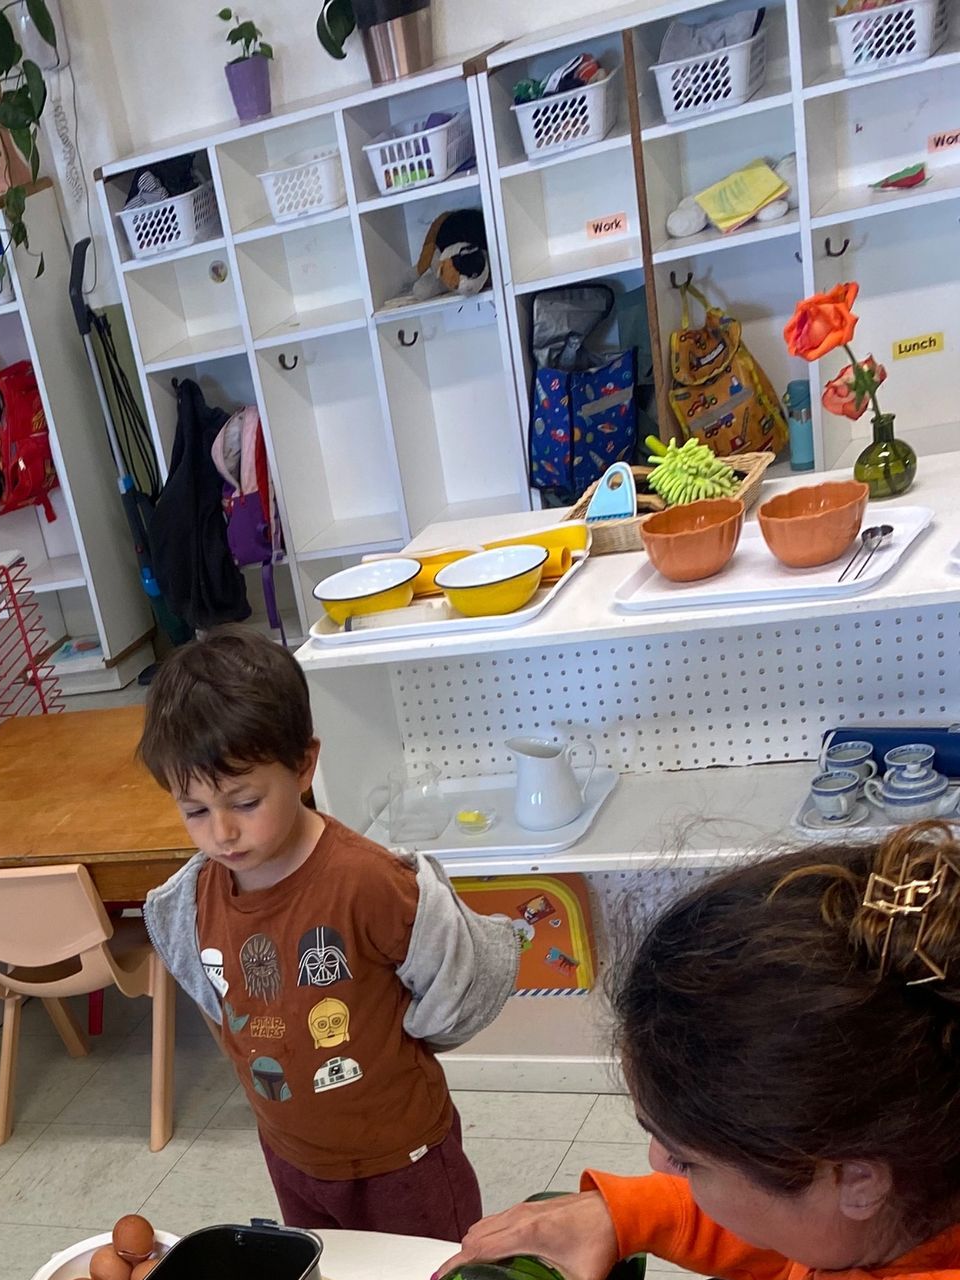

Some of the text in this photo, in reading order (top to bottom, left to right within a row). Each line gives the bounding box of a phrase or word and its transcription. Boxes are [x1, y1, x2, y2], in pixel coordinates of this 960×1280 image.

[592, 218, 622, 234] Work
[898, 336, 936, 354] Lunch
[251, 1016, 285, 1029] STAR
[251, 1026, 285, 1039] WARS
